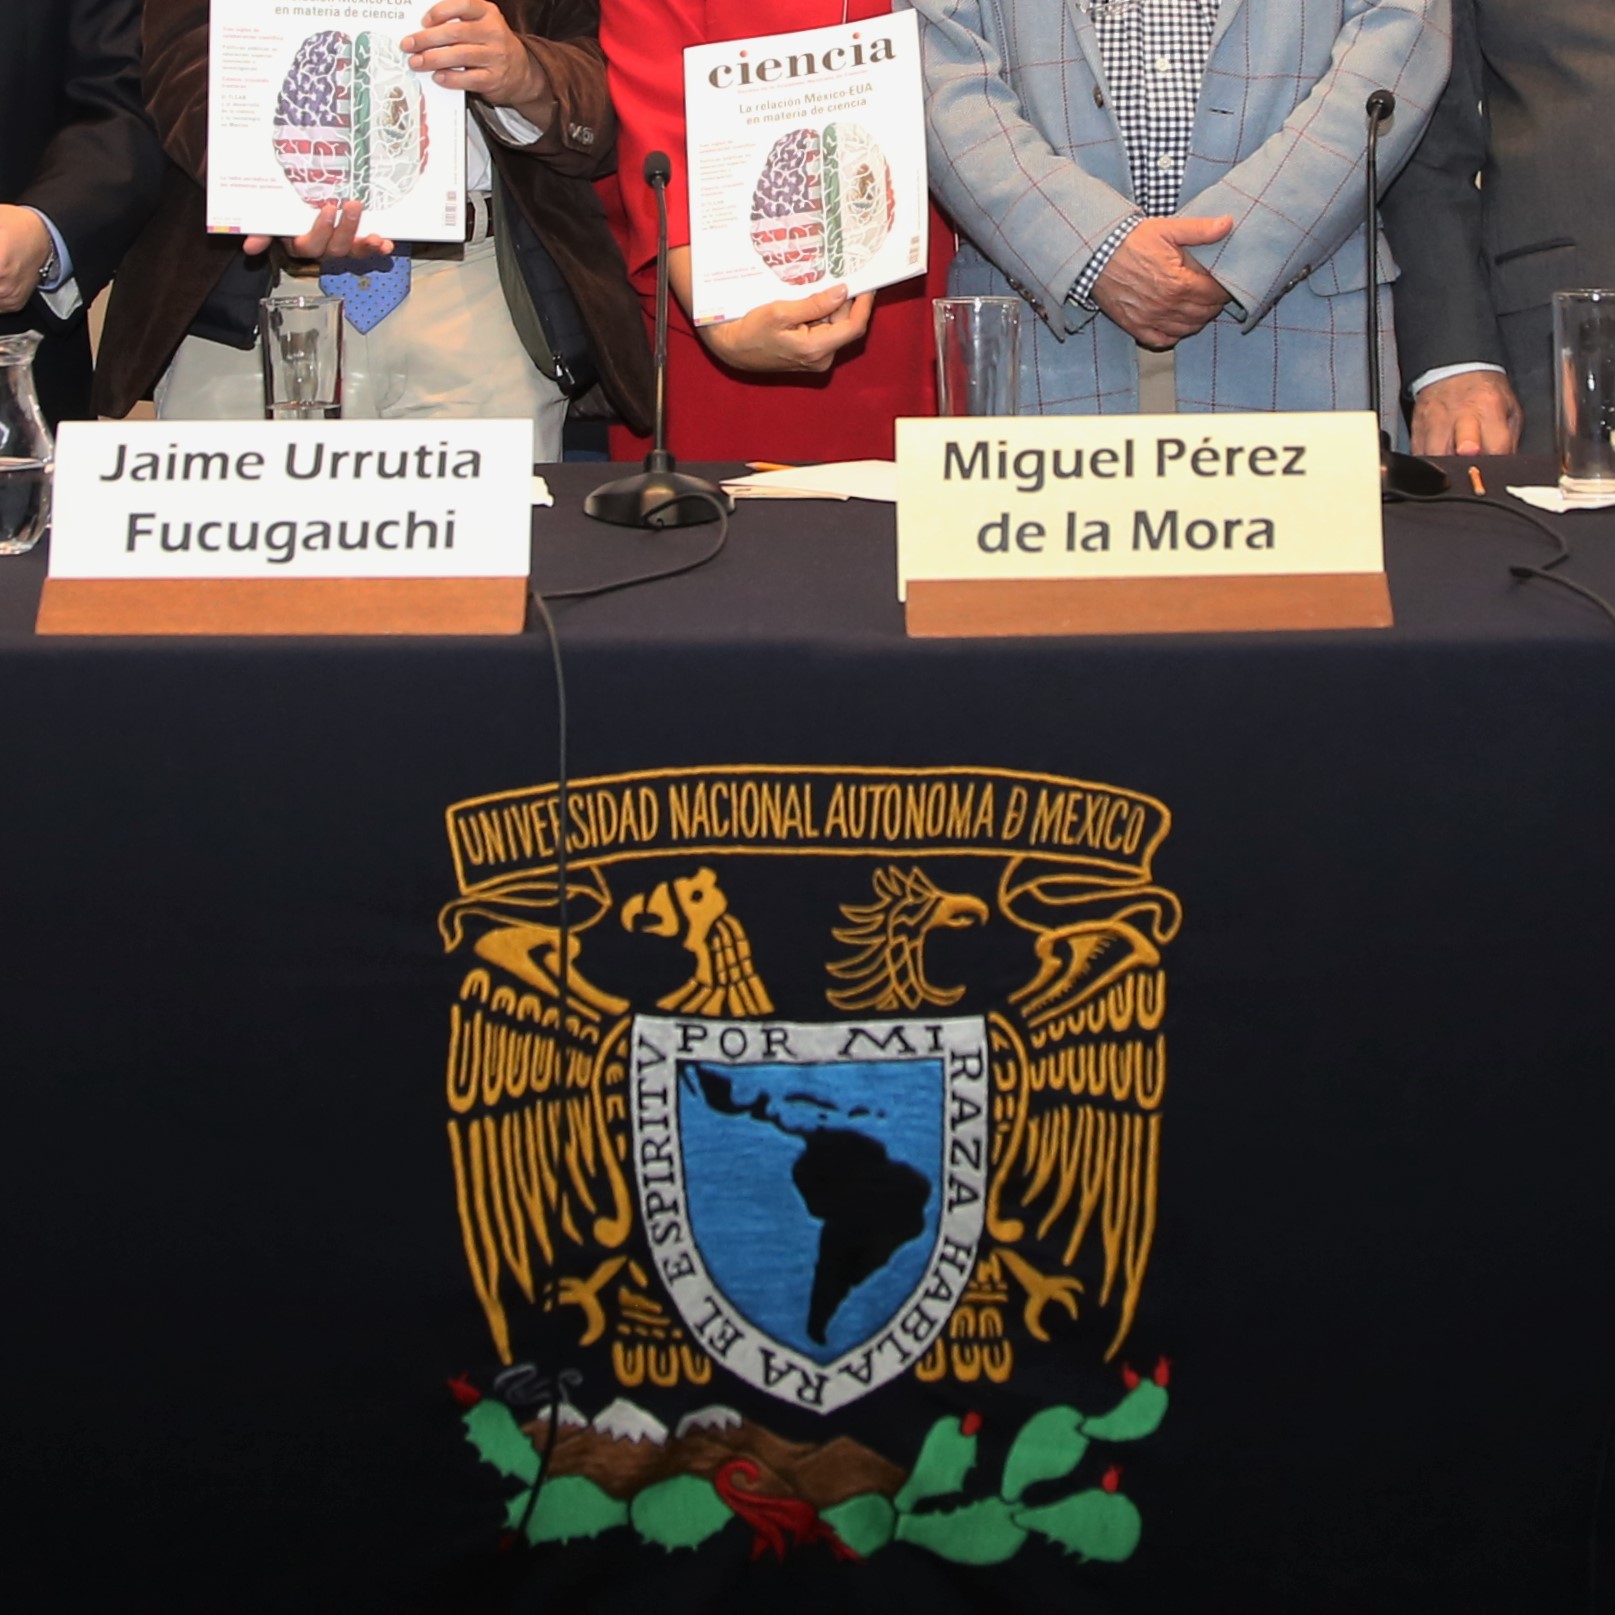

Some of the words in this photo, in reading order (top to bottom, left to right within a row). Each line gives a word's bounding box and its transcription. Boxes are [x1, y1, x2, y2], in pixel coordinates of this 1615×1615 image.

[275, 6, 289, 15] en
[293, 5, 340, 17] materia
[344, 7, 358, 18] de
[362, 8, 405, 20] ciencia
[708, 32, 896, 89] ciencia
[739, 104, 752, 114] La
[755, 97, 801, 112] relación
[746, 116, 760, 125] en
[763, 110, 807, 122] materia
[811, 106, 823, 115] de
[827, 98, 867, 113] ciencia
[99, 442, 265, 482] Jaime
[283, 440, 482, 481] Urrutia
[942, 438, 1134, 493] Miguel
[1155, 437, 1307, 477] Pérez
[125, 509, 456, 564] Fucugauchi
[976, 512, 1046, 553] de
[1065, 511, 1111, 552] la
[1132, 510, 1275, 551] Mora
[669, 781, 819, 841] NACIONAL
[824, 782, 994, 841] AUTONOMA
[1030, 789, 1145, 855] MEXICO
[675, 1024, 797, 1059] POR
[838, 1025, 943, 1056] MI
[948, 1047, 984, 1214] RAZA
[694, 1295, 746, 1358] EL
